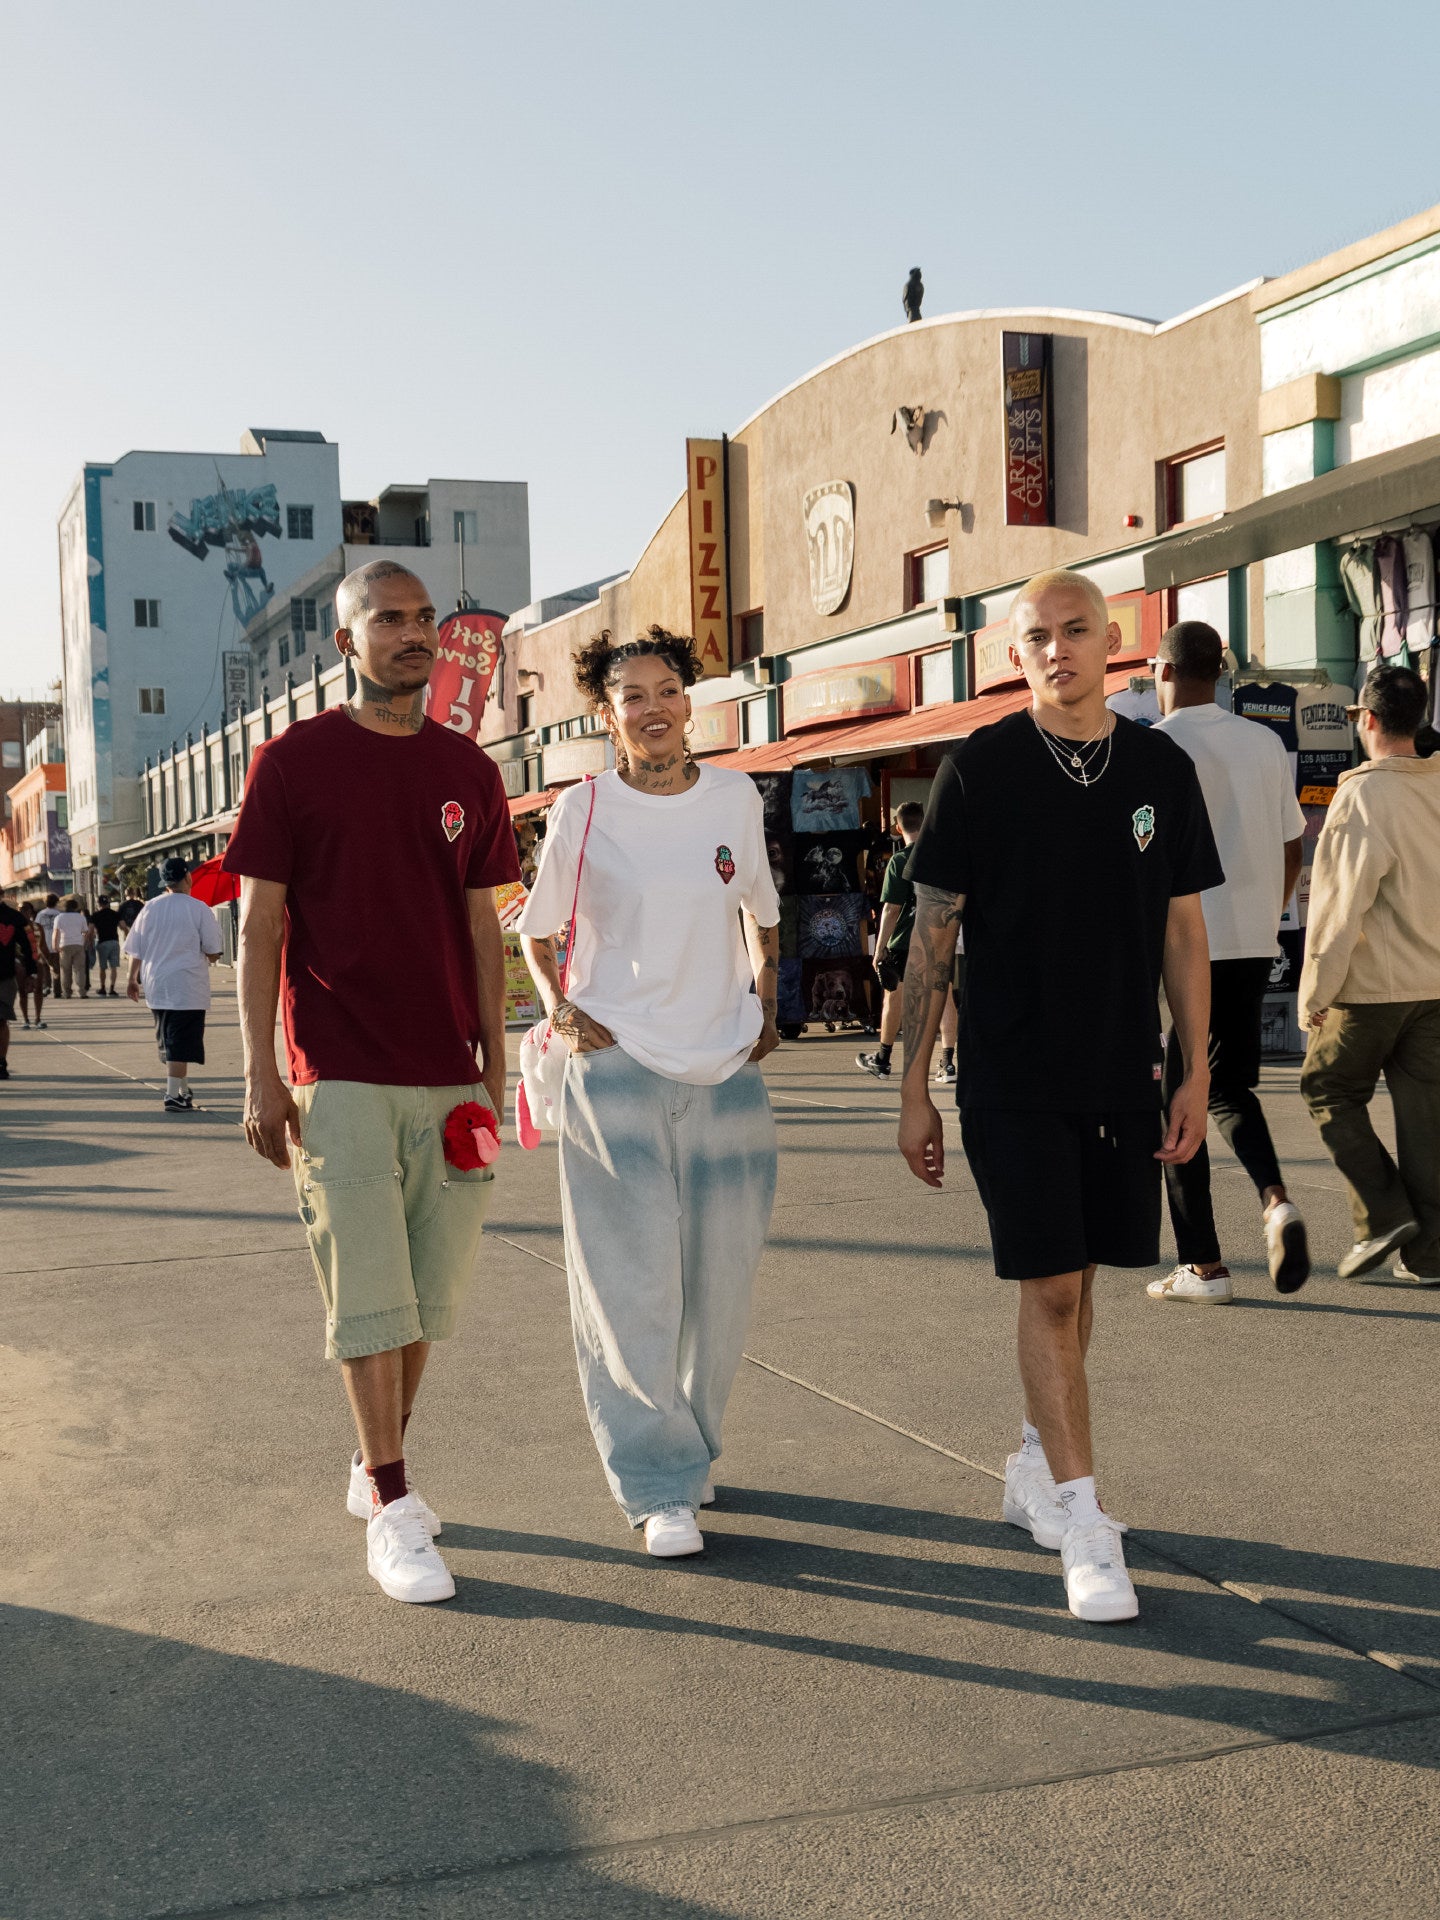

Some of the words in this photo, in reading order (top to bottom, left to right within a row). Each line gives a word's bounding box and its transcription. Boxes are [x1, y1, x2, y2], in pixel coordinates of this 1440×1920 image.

[1009, 408, 1026, 429] &
[1026, 408, 1043, 508] CRAFTS
[1009, 438, 1026, 503] ARTS
[695, 456, 724, 663] PIZZA
[1242, 702, 1268, 712] VENICE
[1268, 704, 1291, 714] BEACH
[1301, 703, 1327, 726] VENICE
[1300, 753, 1314, 764] LOS
[1315, 753, 1347, 763] ANGELES
